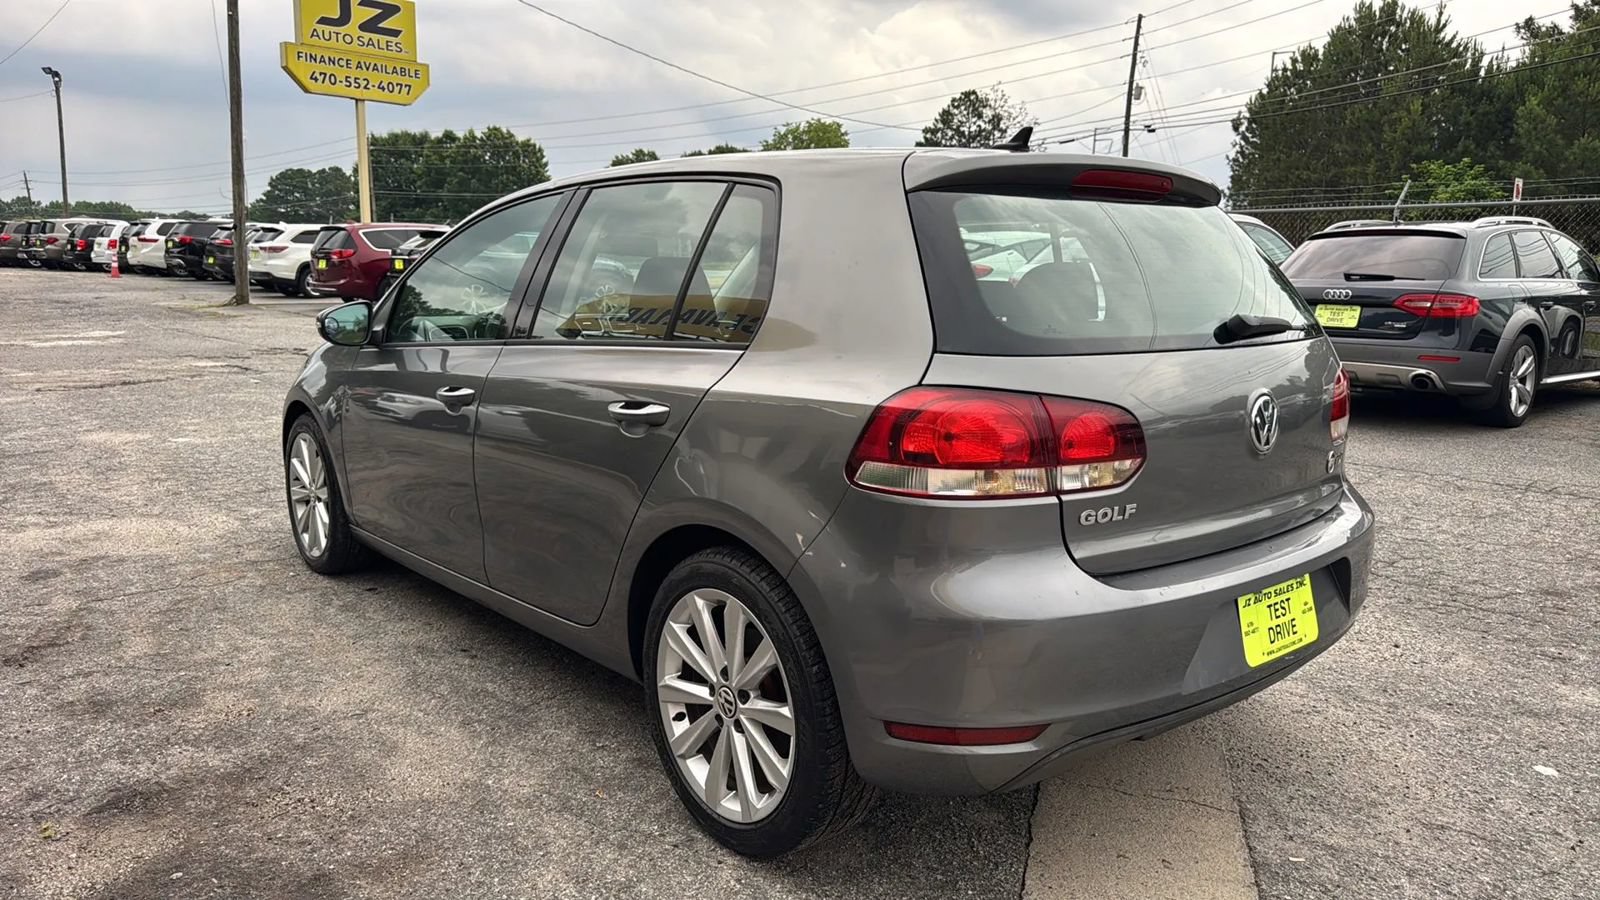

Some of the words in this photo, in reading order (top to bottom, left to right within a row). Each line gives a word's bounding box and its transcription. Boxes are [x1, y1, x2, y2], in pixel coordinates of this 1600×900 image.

[315, 0, 403, 38] JZ
[309, 27, 354, 45] AUTO
[357, 35, 403, 54] SALES
[296, 51, 352, 69] FINANCE
[355, 60, 421, 79] AVAILABLE
[309, 70, 412, 96] 470-552-4077
[1079, 503, 1137, 526] GOLF
[1242, 598, 1253, 608] JZ
[1253, 591, 1272, 605] AUTO
[1274, 583, 1294, 598] SALES
[1295, 579, 1307, 589] INC
[1266, 597, 1291, 621] TEST
[1268, 618, 1298, 645] DRIVE
